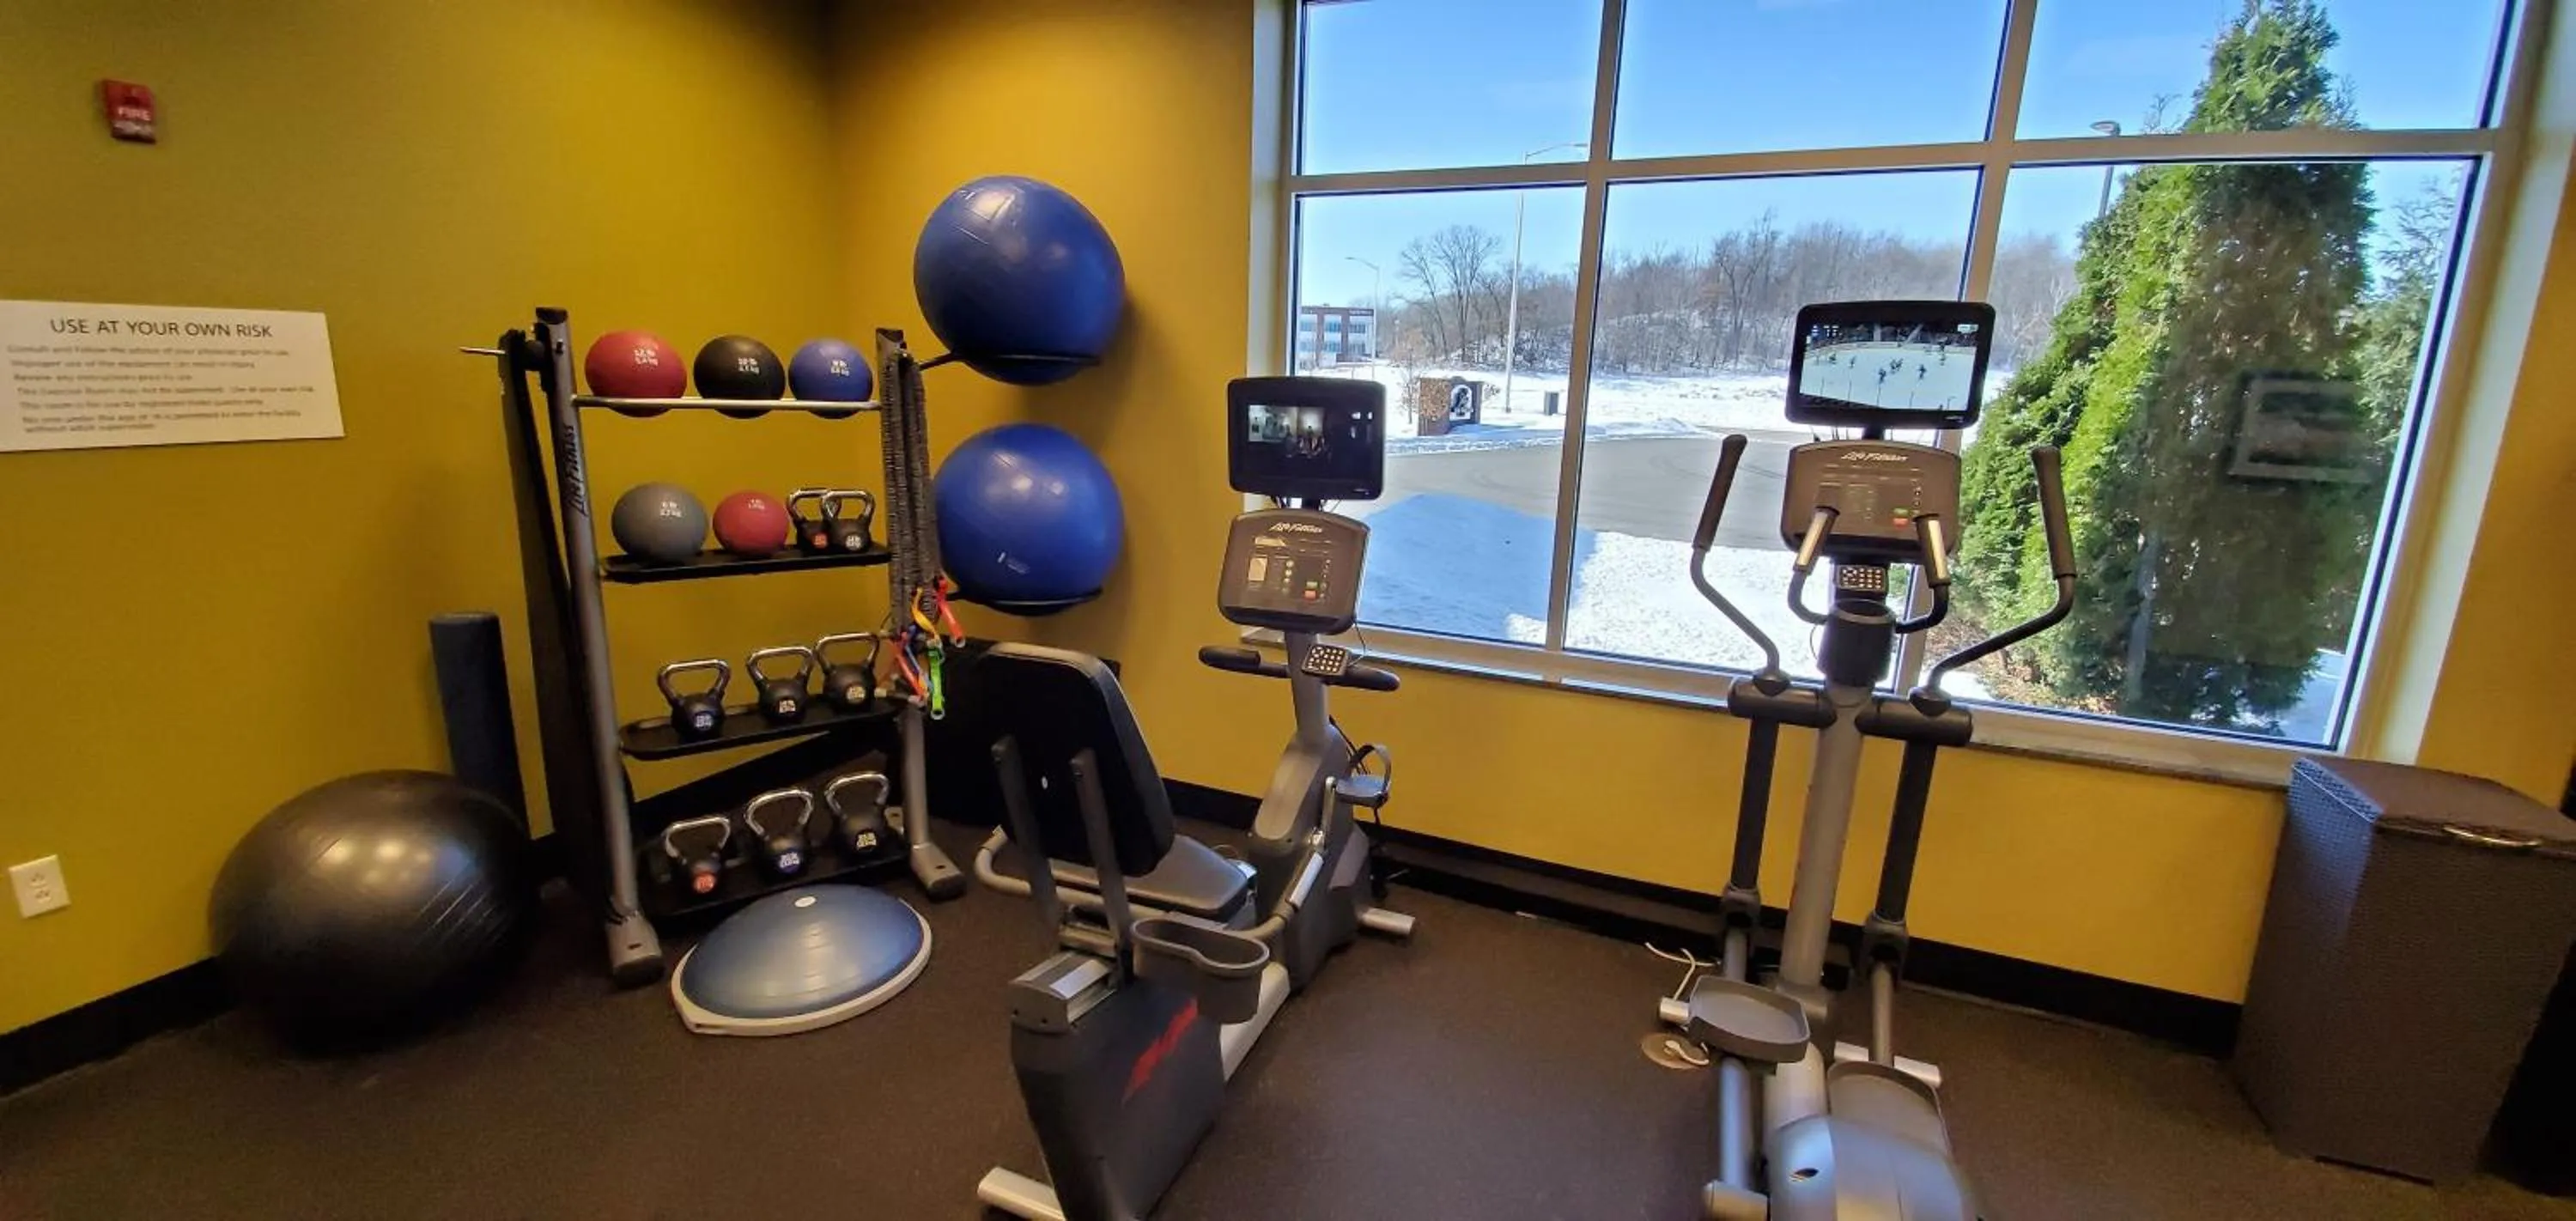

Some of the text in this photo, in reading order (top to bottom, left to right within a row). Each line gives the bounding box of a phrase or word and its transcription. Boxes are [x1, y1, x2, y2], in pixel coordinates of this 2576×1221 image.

[50, 319, 274, 338] USE AT YOUR OWN RISK
